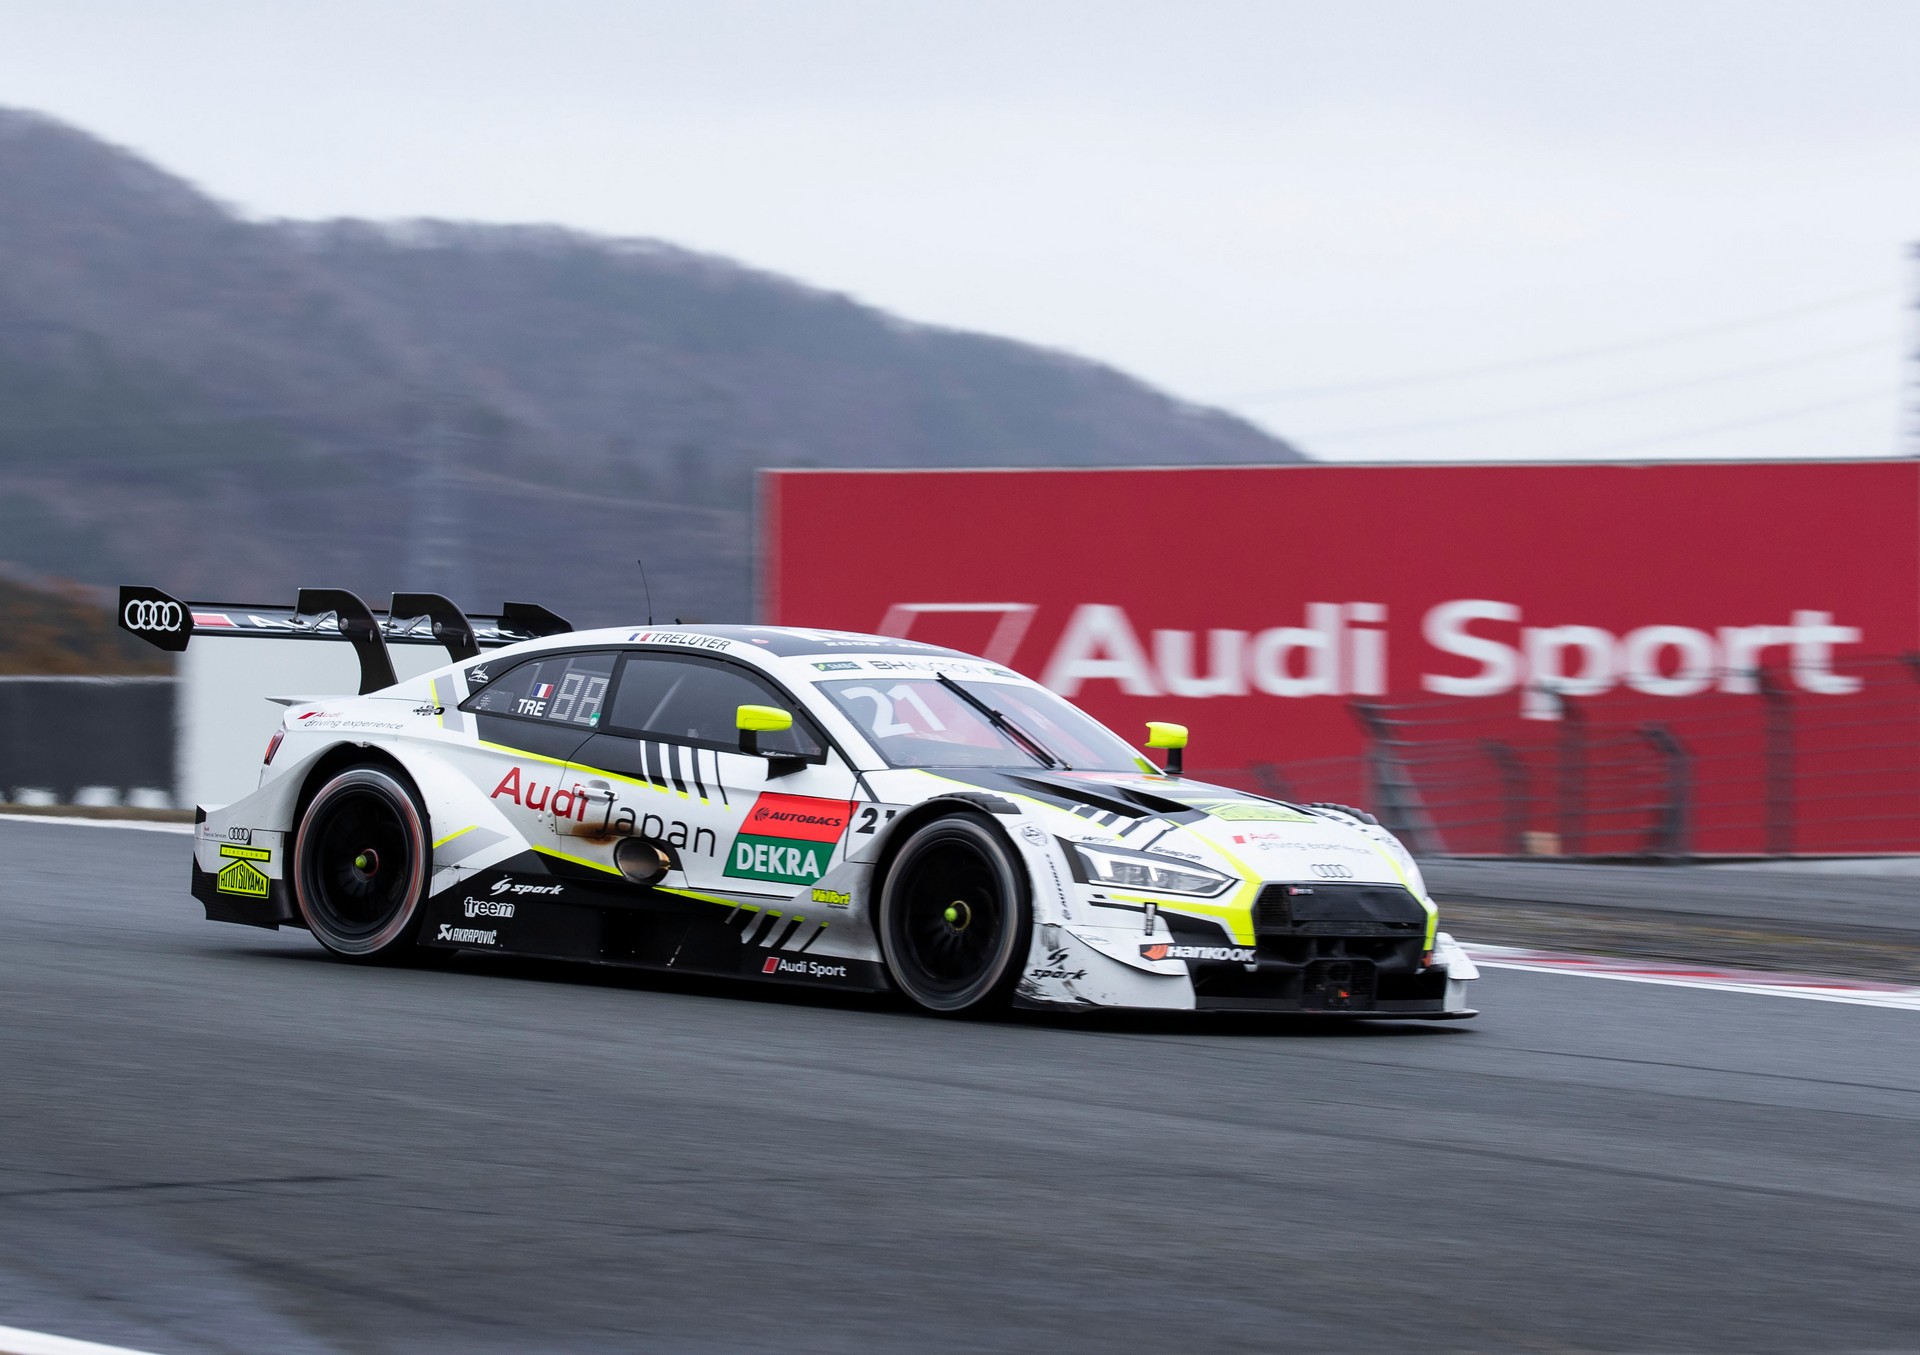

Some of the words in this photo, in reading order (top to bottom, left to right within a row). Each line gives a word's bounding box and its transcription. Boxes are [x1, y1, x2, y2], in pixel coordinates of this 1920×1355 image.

[651, 633, 732, 651] TRELUYER
[1040, 602, 1388, 698] Audi
[1420, 599, 1863, 720] Sport
[313, 711, 344, 719] Audi
[517, 698, 546, 717] TRE
[840, 685, 947, 738] 21
[304, 719, 341, 728] driving
[343, 719, 404, 730] experience
[490, 766, 590, 823] Audi
[597, 790, 717, 858] Japan
[769, 812, 843, 827] AUTOBACS
[736, 842, 820, 879] DEKRA
[221, 864, 265, 893] HITOTSUYAMA
[510, 884, 564, 895] spark
[464, 897, 515, 917] freem
[779, 958, 807, 973] Audi
[808, 961, 847, 978] Sport
[1029, 967, 1089, 981] spark
